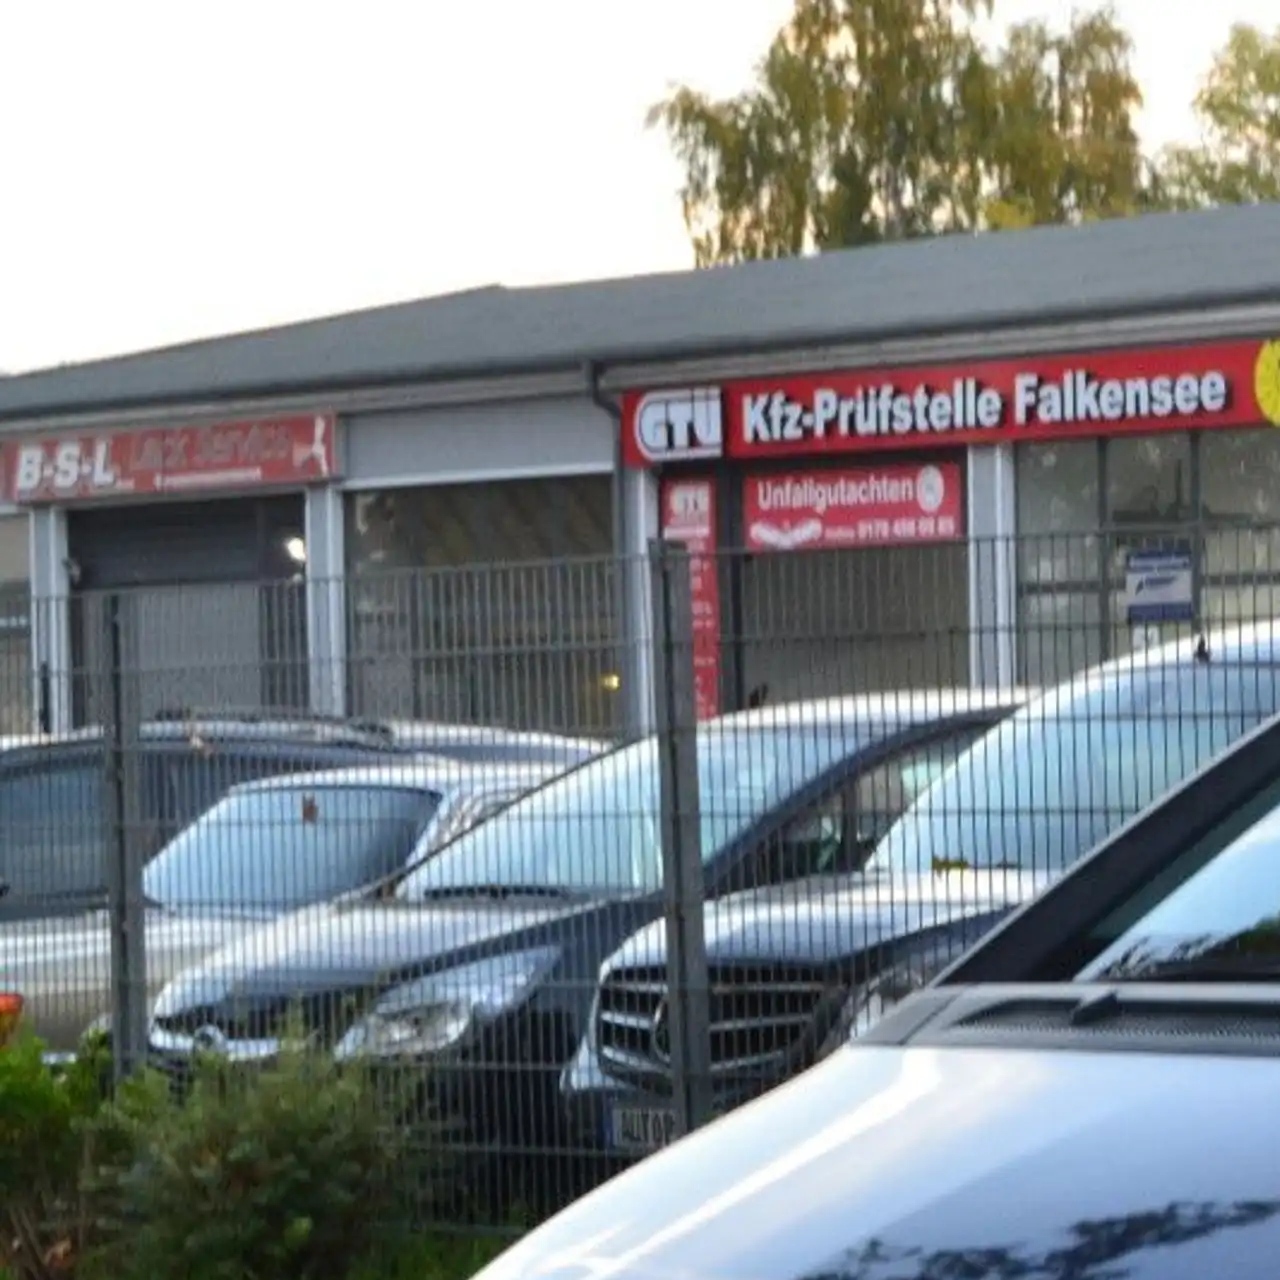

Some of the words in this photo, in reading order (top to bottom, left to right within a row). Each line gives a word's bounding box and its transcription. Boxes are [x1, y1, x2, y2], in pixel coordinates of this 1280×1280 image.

[639, 390, 722, 448] GTÜ
[742, 380, 1001, 443] Kfz-Prüfstelle
[1014, 370, 1227, 421] Falkensee
[757, 475, 913, 514] Unfallgutachten
